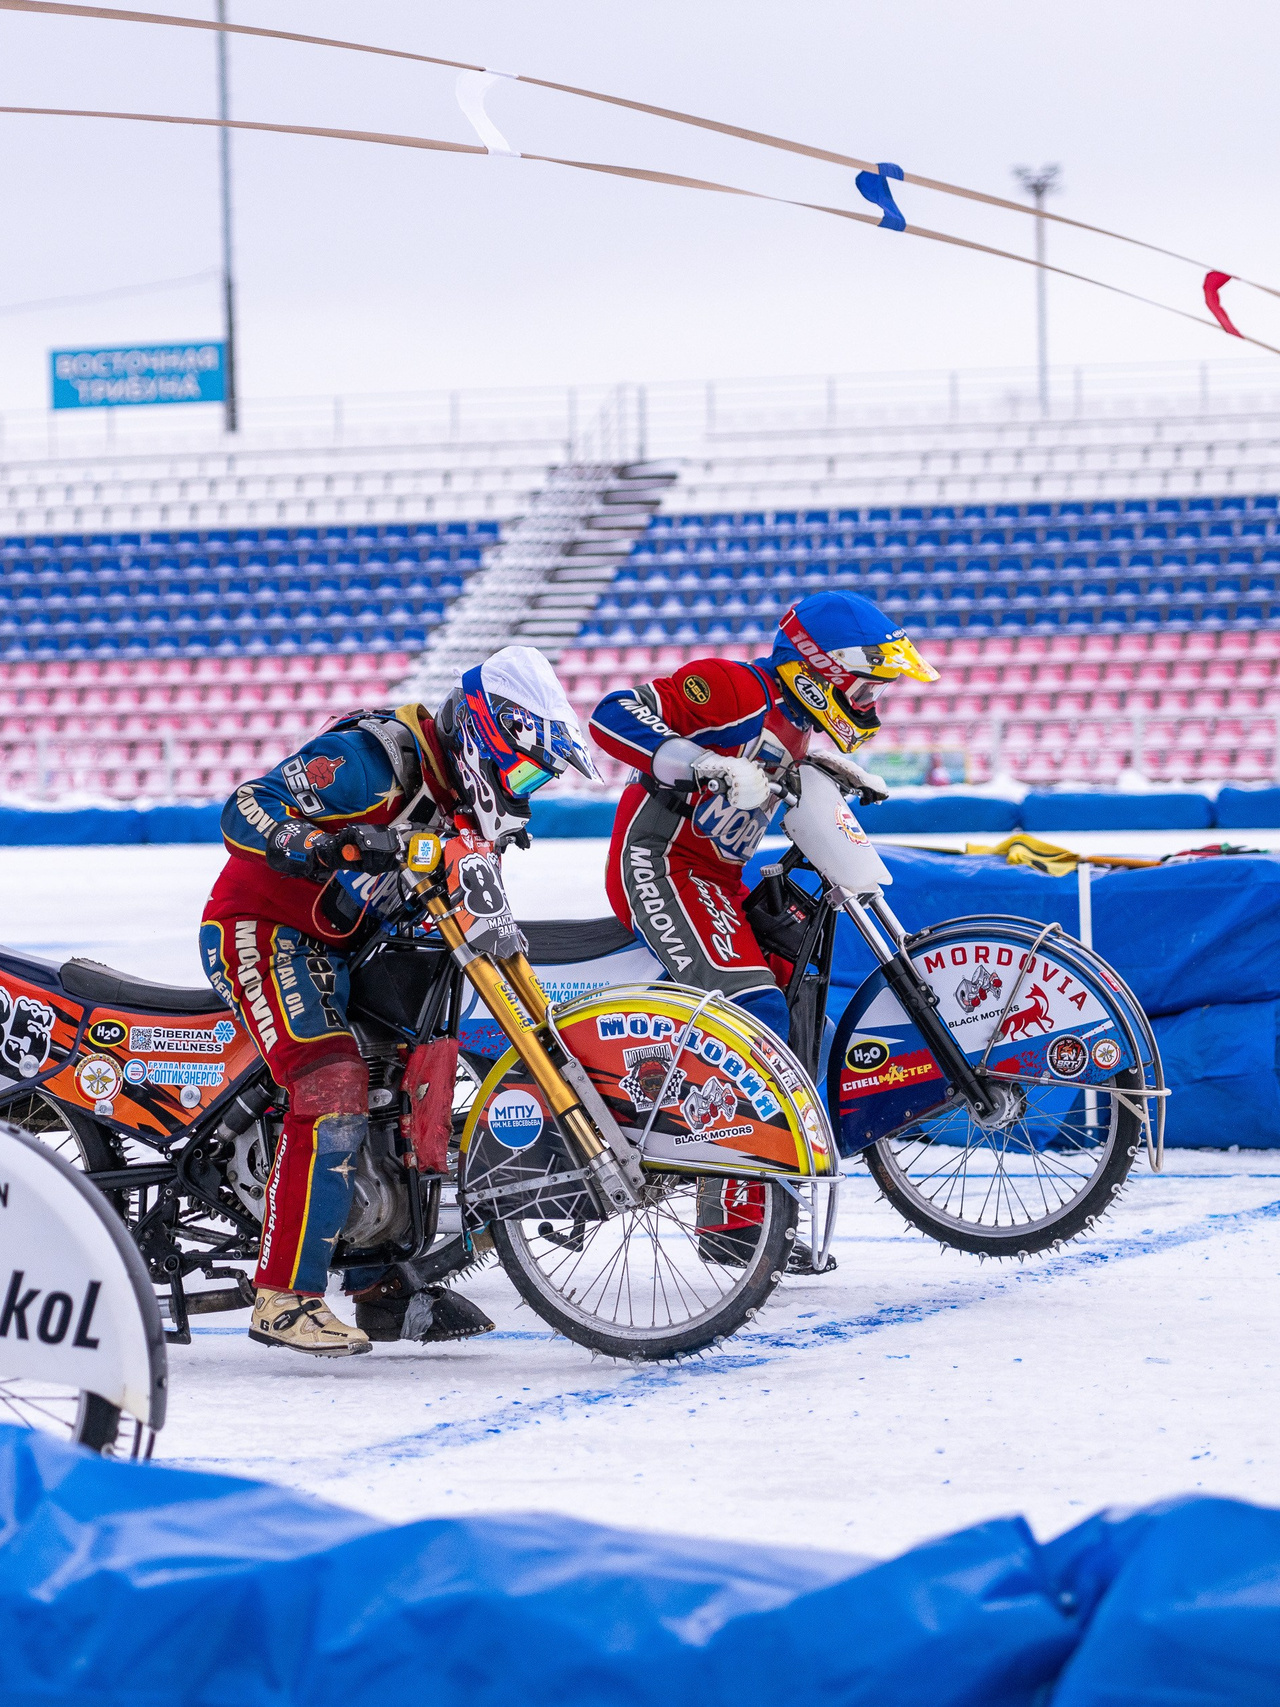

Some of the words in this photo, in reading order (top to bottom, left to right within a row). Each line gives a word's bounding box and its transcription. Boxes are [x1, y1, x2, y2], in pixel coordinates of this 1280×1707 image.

[791, 630, 850, 685] 100%
[796, 680, 825, 706] Arai
[630, 845, 693, 973] MORDOVIA
[924, 945, 1088, 1012] MORDOVIA
[285, 992, 306, 1020] OIL
[948, 1013, 979, 1029] BLACK
[96, 1025, 120, 1040] H2O
[153, 1028, 212, 1040] SIBERIAN
[153, 1041, 222, 1053] WELLNESS
[626, 1045, 672, 1066] МОТОШКОЛА
[854, 1047, 881, 1064] H2O
[148, 1062, 179, 1070] ГРУППА
[181, 1062, 225, 1071] КОМПАНИЙ
[598, 1015, 779, 1120] МОРДОВИЯ
[148, 1070, 223, 1085] «ОПТИКЭНЕРГО»
[842, 1063, 933, 1092] СПЕЦМАСТЕР
[494, 1104, 535, 1119] МГПУ
[675, 1133, 708, 1145] BLACK
[710, 1125, 753, 1140] MOTORS
